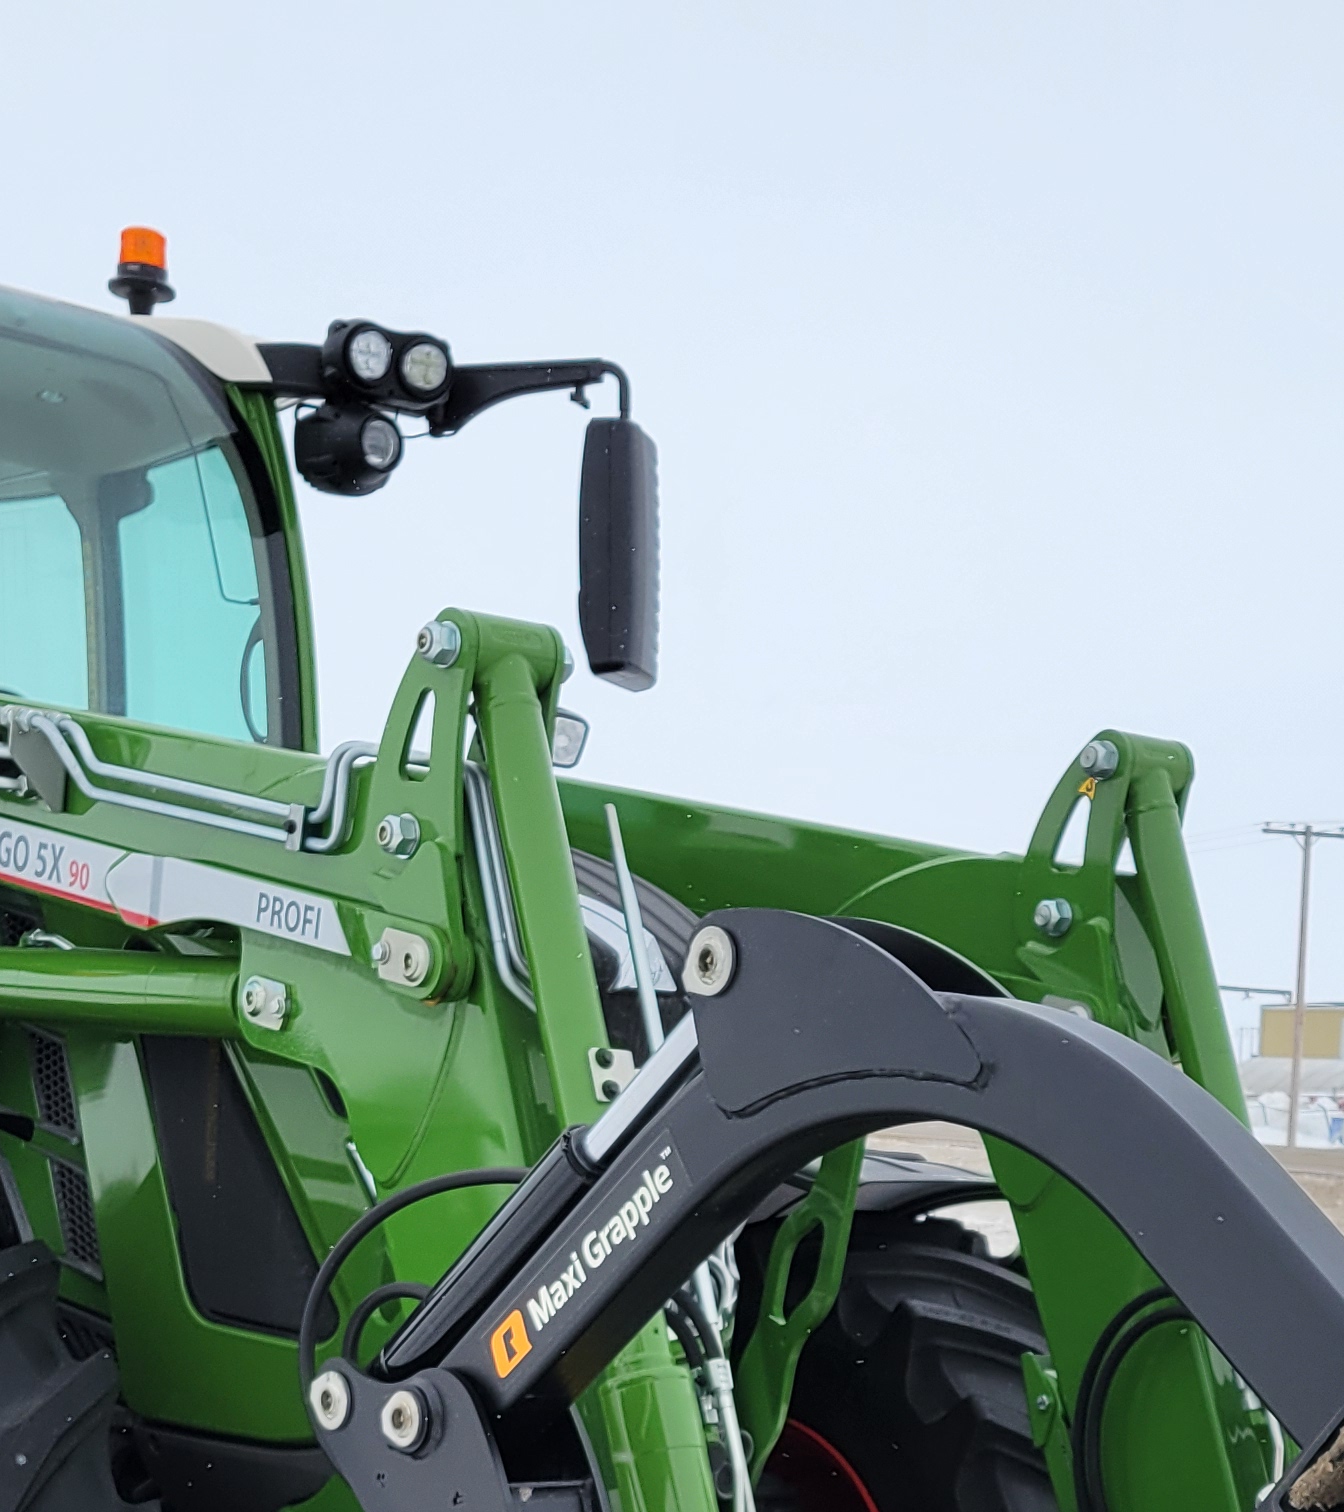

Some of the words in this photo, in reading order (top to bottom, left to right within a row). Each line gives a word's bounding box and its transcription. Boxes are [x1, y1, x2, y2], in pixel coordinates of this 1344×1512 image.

[34, 841, 65, 884] 5X
[68, 859, 90, 891] 90
[256, 891, 322, 940] PROFI
[526, 1250, 587, 1332] Maxi
